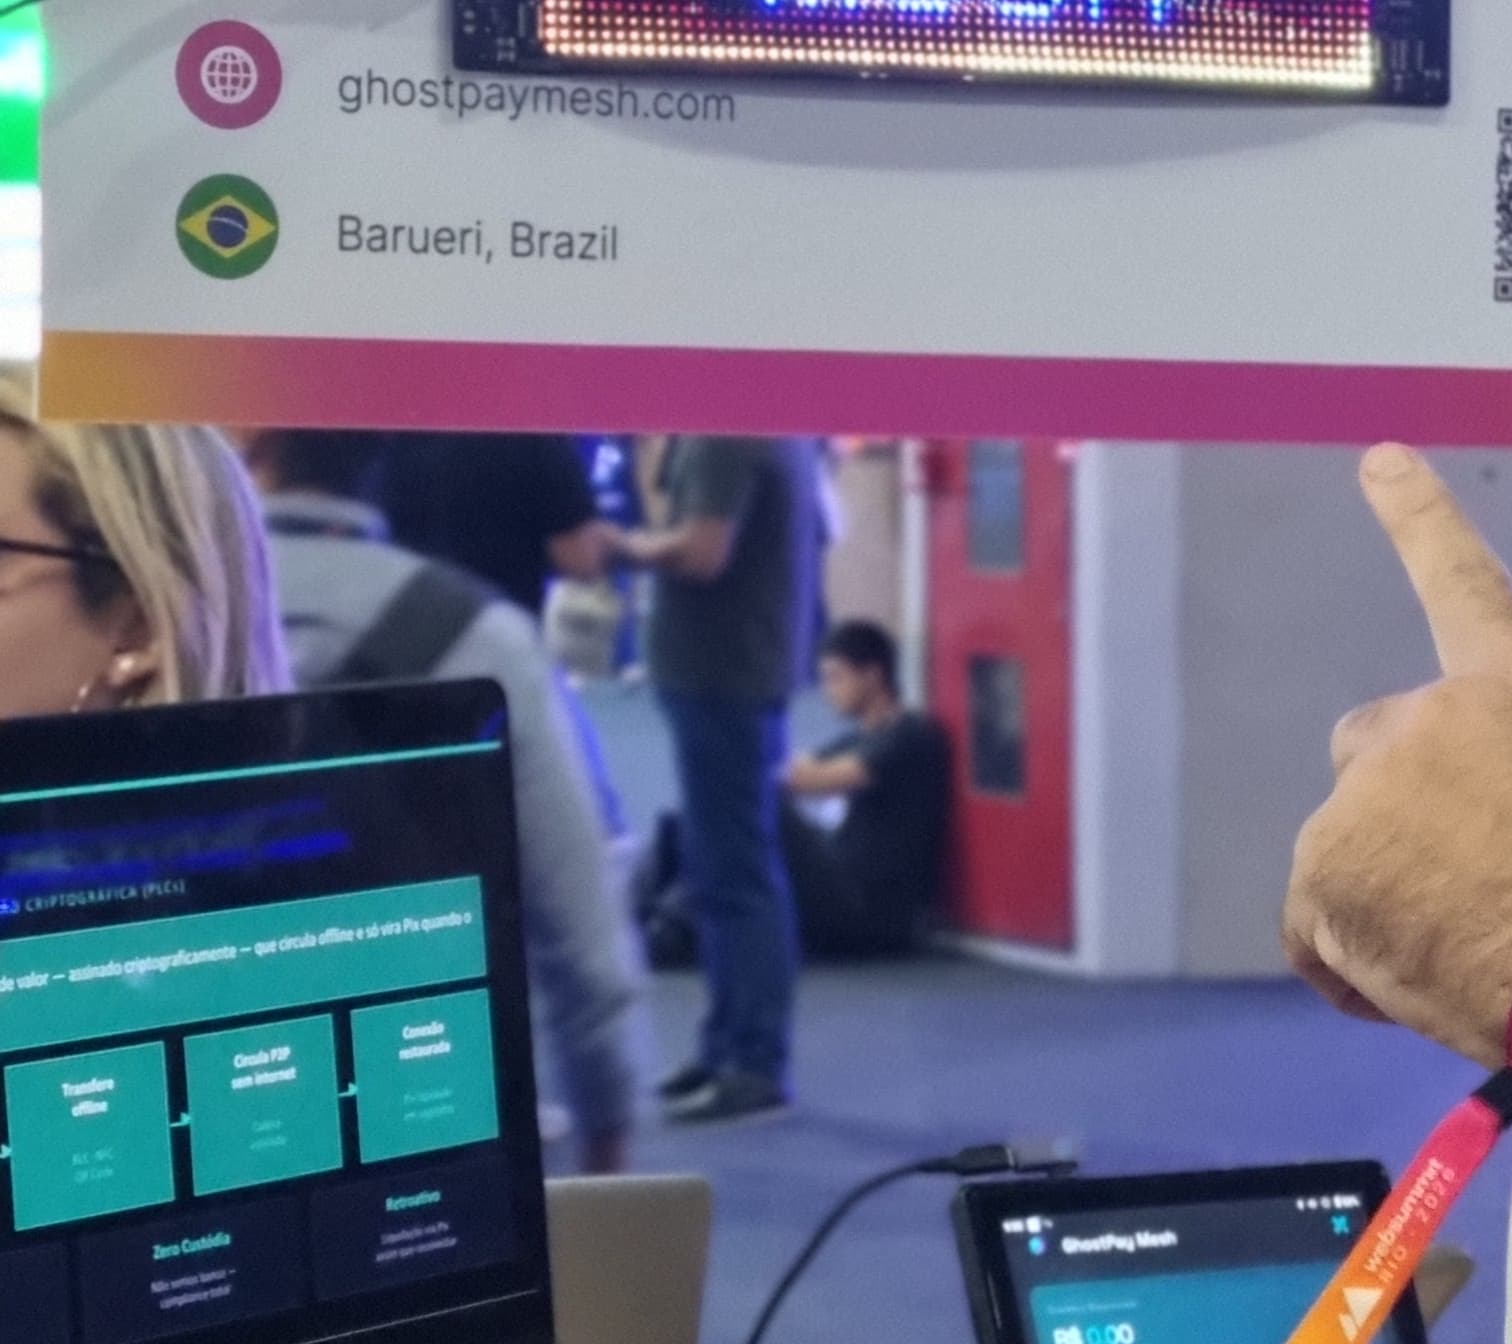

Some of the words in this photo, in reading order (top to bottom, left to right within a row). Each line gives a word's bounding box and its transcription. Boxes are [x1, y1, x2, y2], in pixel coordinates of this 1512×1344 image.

[337, 68, 737, 123] ghostpaymesh.com
[336, 214, 494, 265] Barueri,
[509, 221, 620, 262] Brazil
[68, 960, 123, 983] assinado
[123, 945, 238, 974] criptograficamente
[254, 939, 277, 957] que
[278, 931, 317, 953] circula
[420, 911, 463, 933] quando
[1060, 1231, 1136, 1255] GhostPay
[1135, 1228, 1179, 1249] Mesh
[1362, 1156, 1444, 1274] websummit
